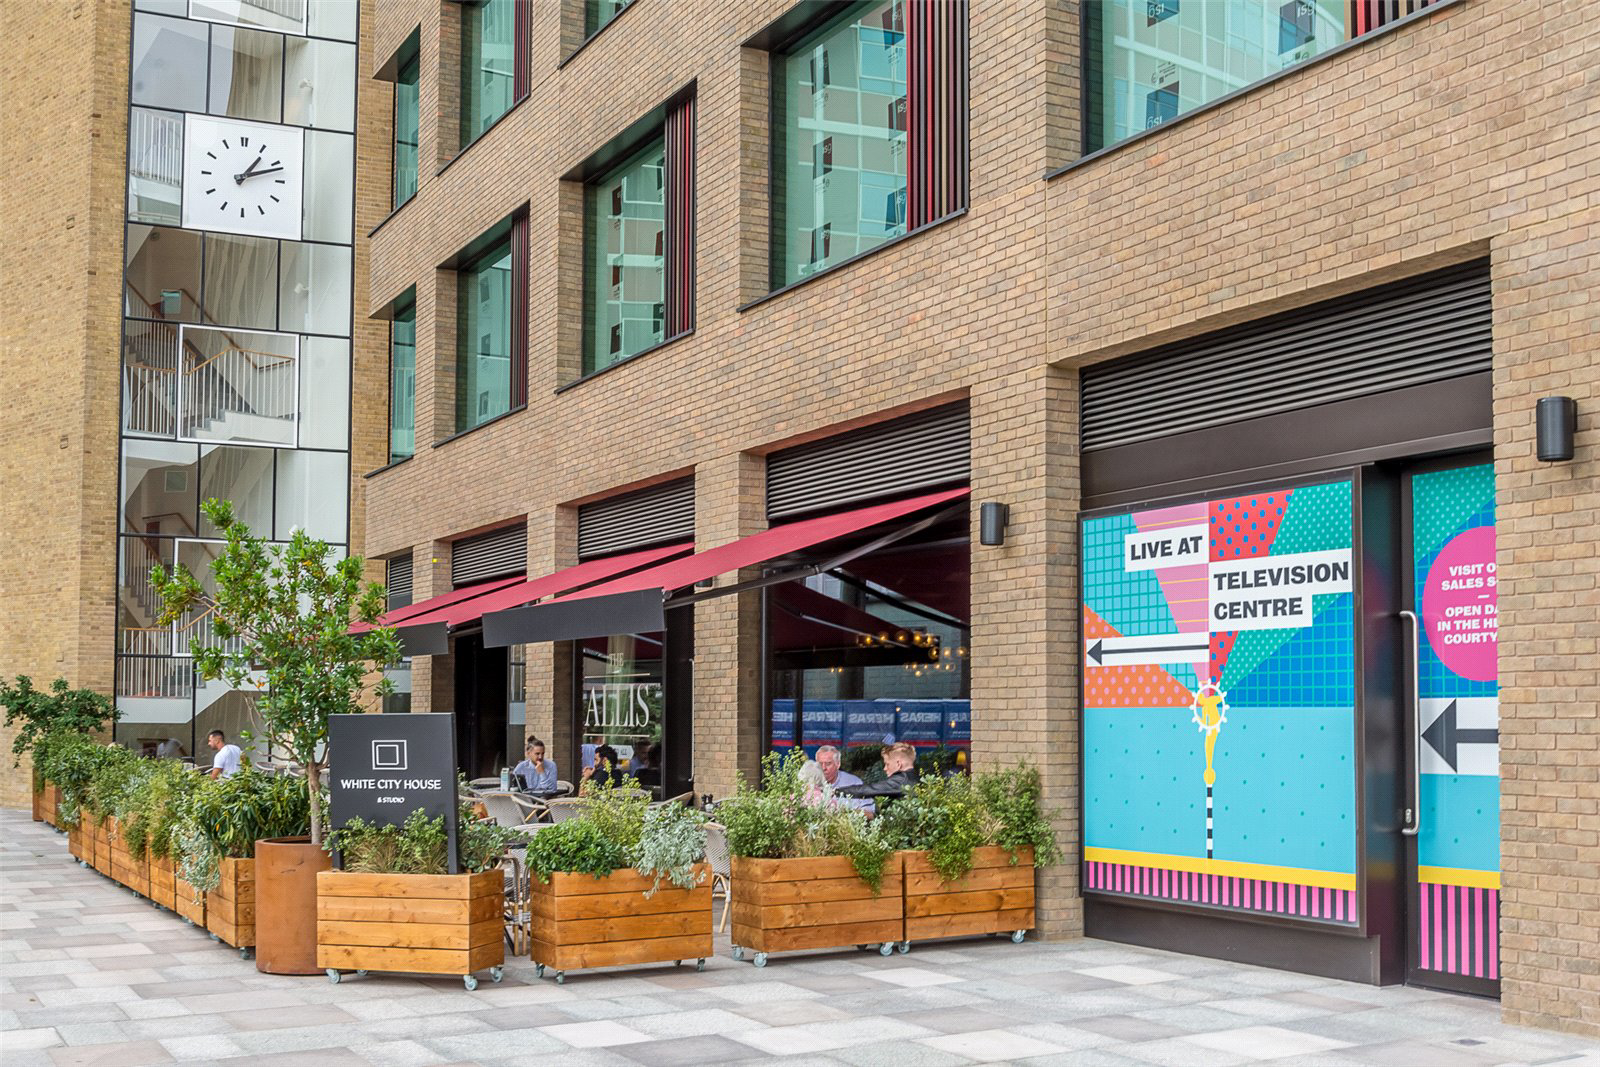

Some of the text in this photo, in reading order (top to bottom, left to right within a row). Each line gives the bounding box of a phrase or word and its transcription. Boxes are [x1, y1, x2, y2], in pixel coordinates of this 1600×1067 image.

[1130, 536, 1203, 560] LIVE AT
[1213, 561, 1349, 590] TELEVISION
[1449, 563, 1484, 576] VISIT
[1441, 578, 1484, 590] SALES
[1214, 597, 1303, 620] CENTRE
[1445, 605, 1482, 617] OPEN
[1437, 621, 1451, 632] IN
[1454, 619, 1480, 630] THE
[608, 653, 624, 666] THE
[584, 684, 649, 728] ALLIS
[341, 780, 441, 790] WHITE CITY HOUSE
